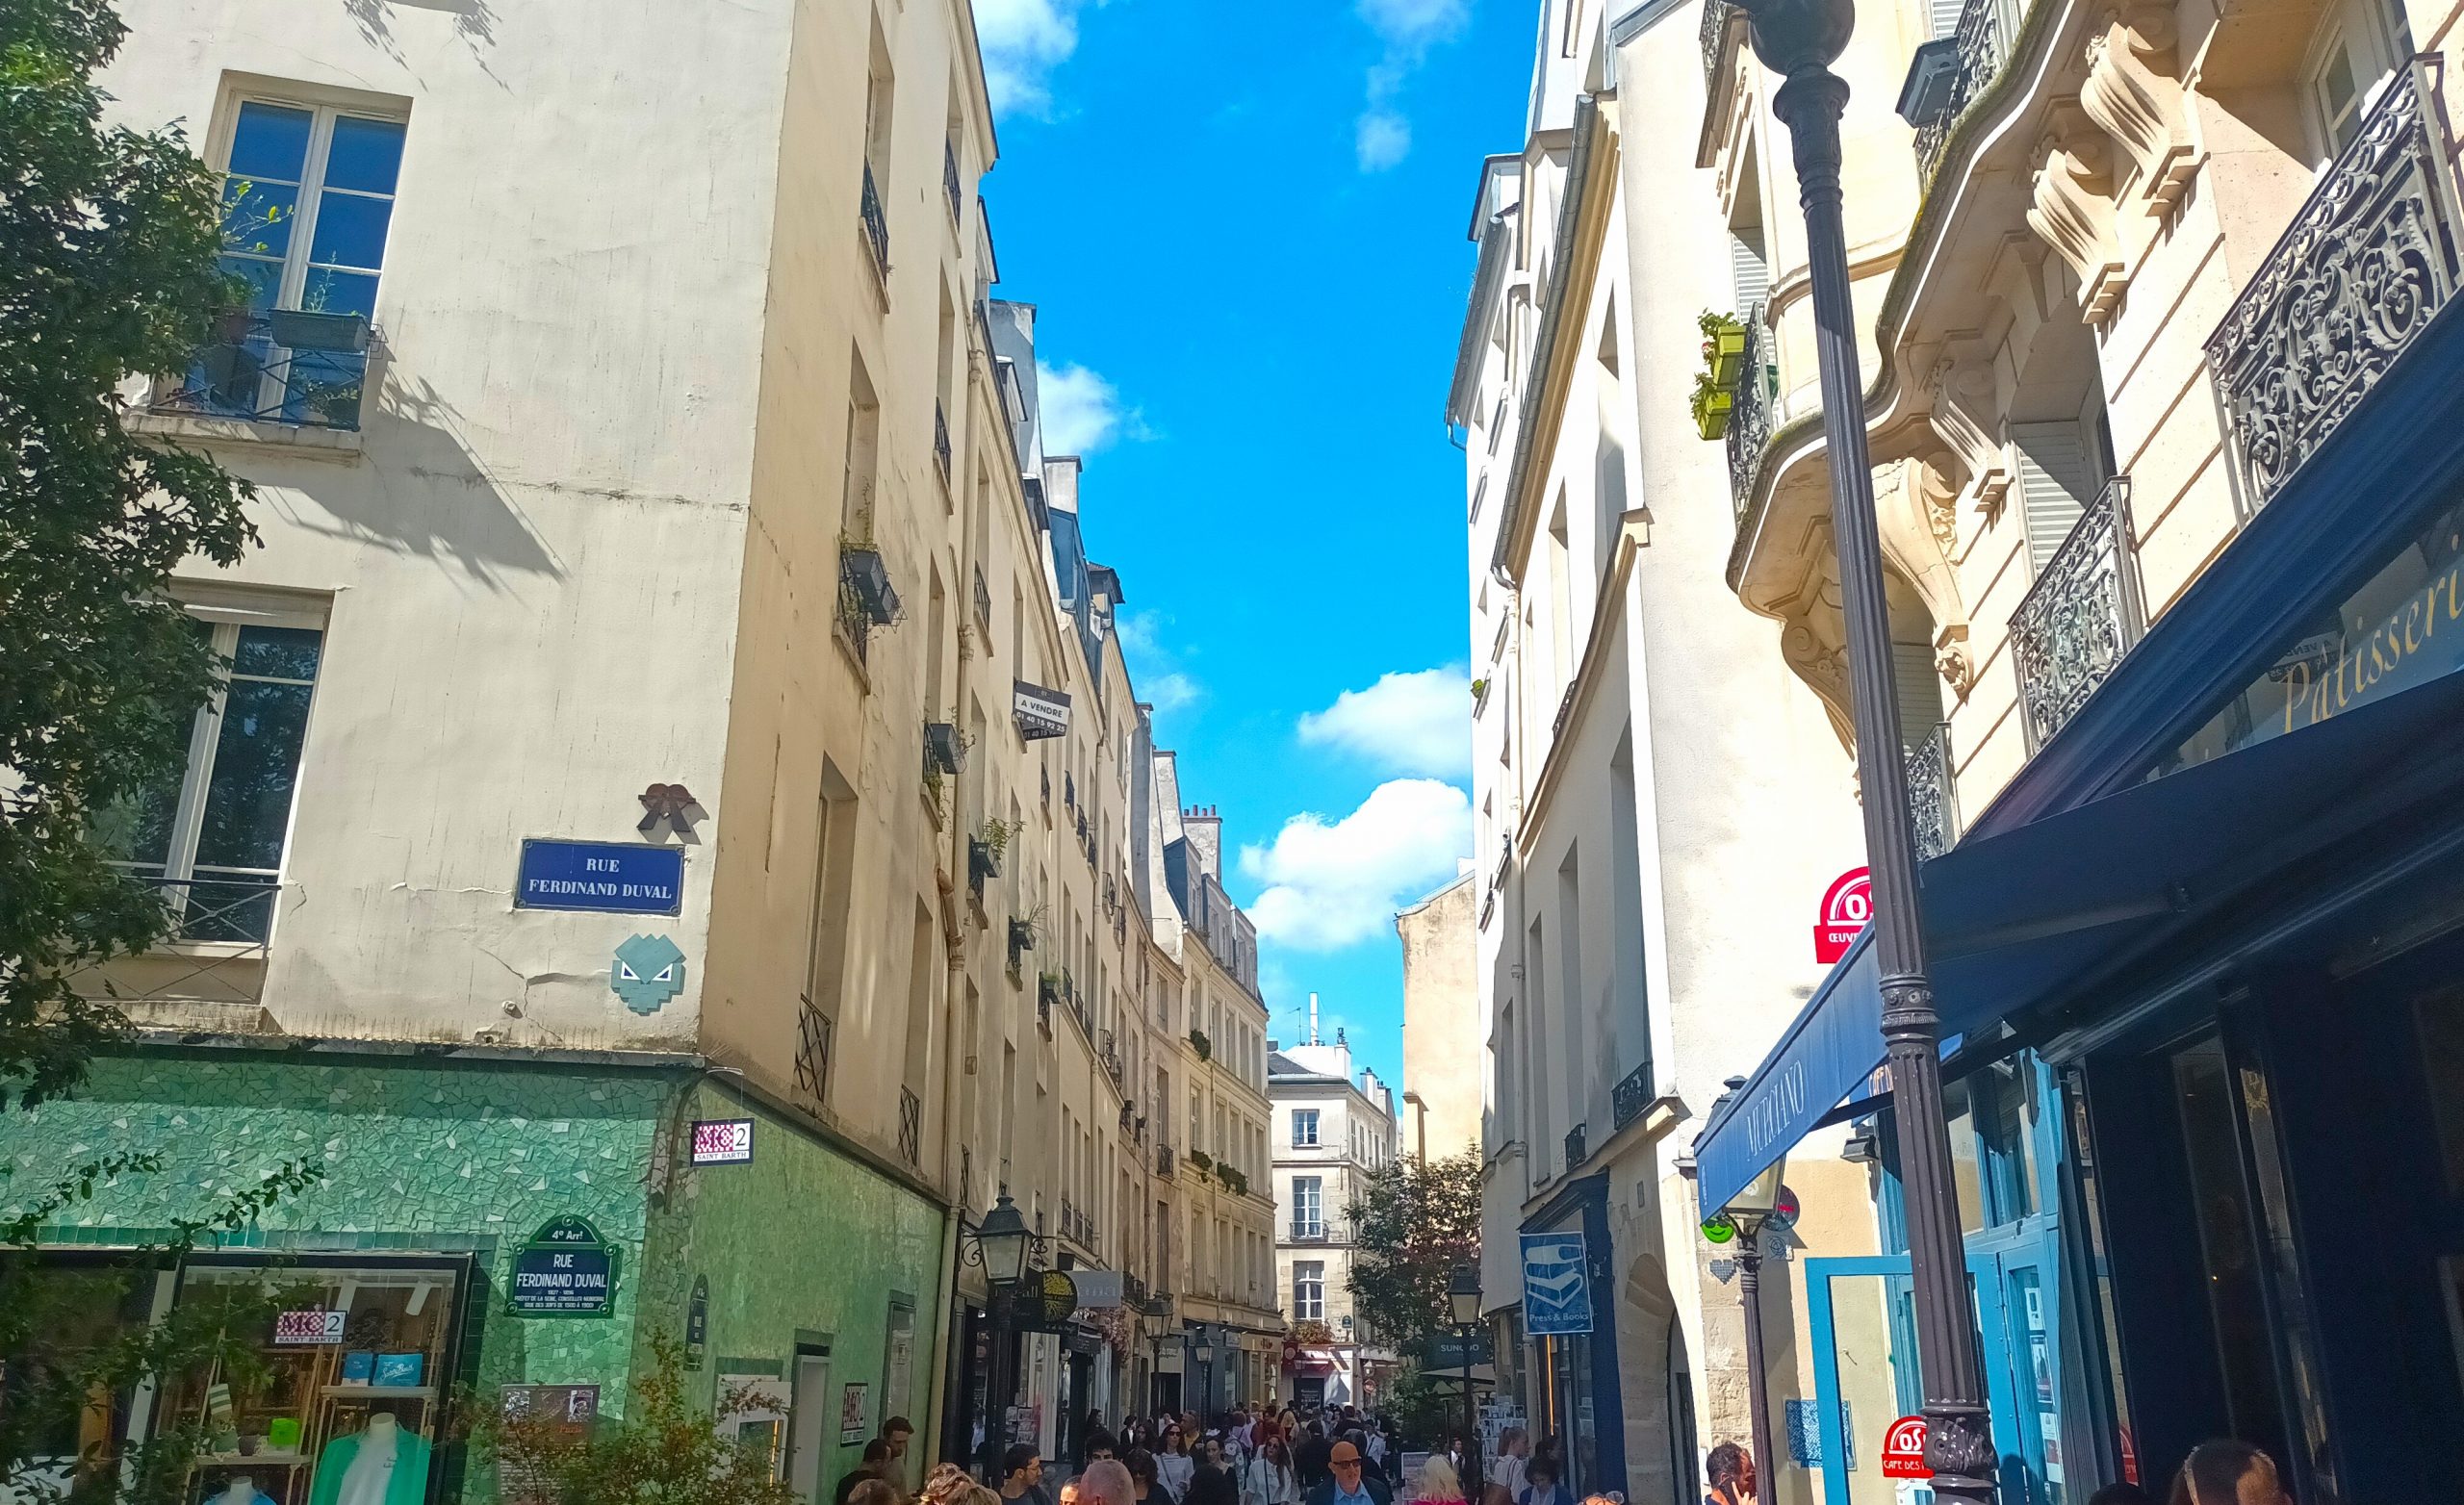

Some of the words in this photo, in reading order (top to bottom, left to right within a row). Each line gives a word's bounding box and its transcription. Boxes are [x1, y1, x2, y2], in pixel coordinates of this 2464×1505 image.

[1030, 701, 1064, 718] VENDRE
[1016, 711, 1025, 720] 01
[1037, 718, 1045, 727] 15
[585, 858, 620, 873] RUE
[528, 879, 618, 897] FERDINAND
[622, 884, 672, 899] DUVAL
[552, 1254, 575, 1268] RUE
[516, 1273, 573, 1288] FERDINAND
[575, 1273, 606, 1288] DUVAL
[1528, 1314, 1552, 1323] Press
[1553, 1313, 1560, 1321] &
[1563, 1312, 1589, 1321] Books
[1899, 1427, 1927, 1451] OS
[1883, 1460, 1903, 1470] CAFE
[1904, 1461, 1920, 1471] DES
